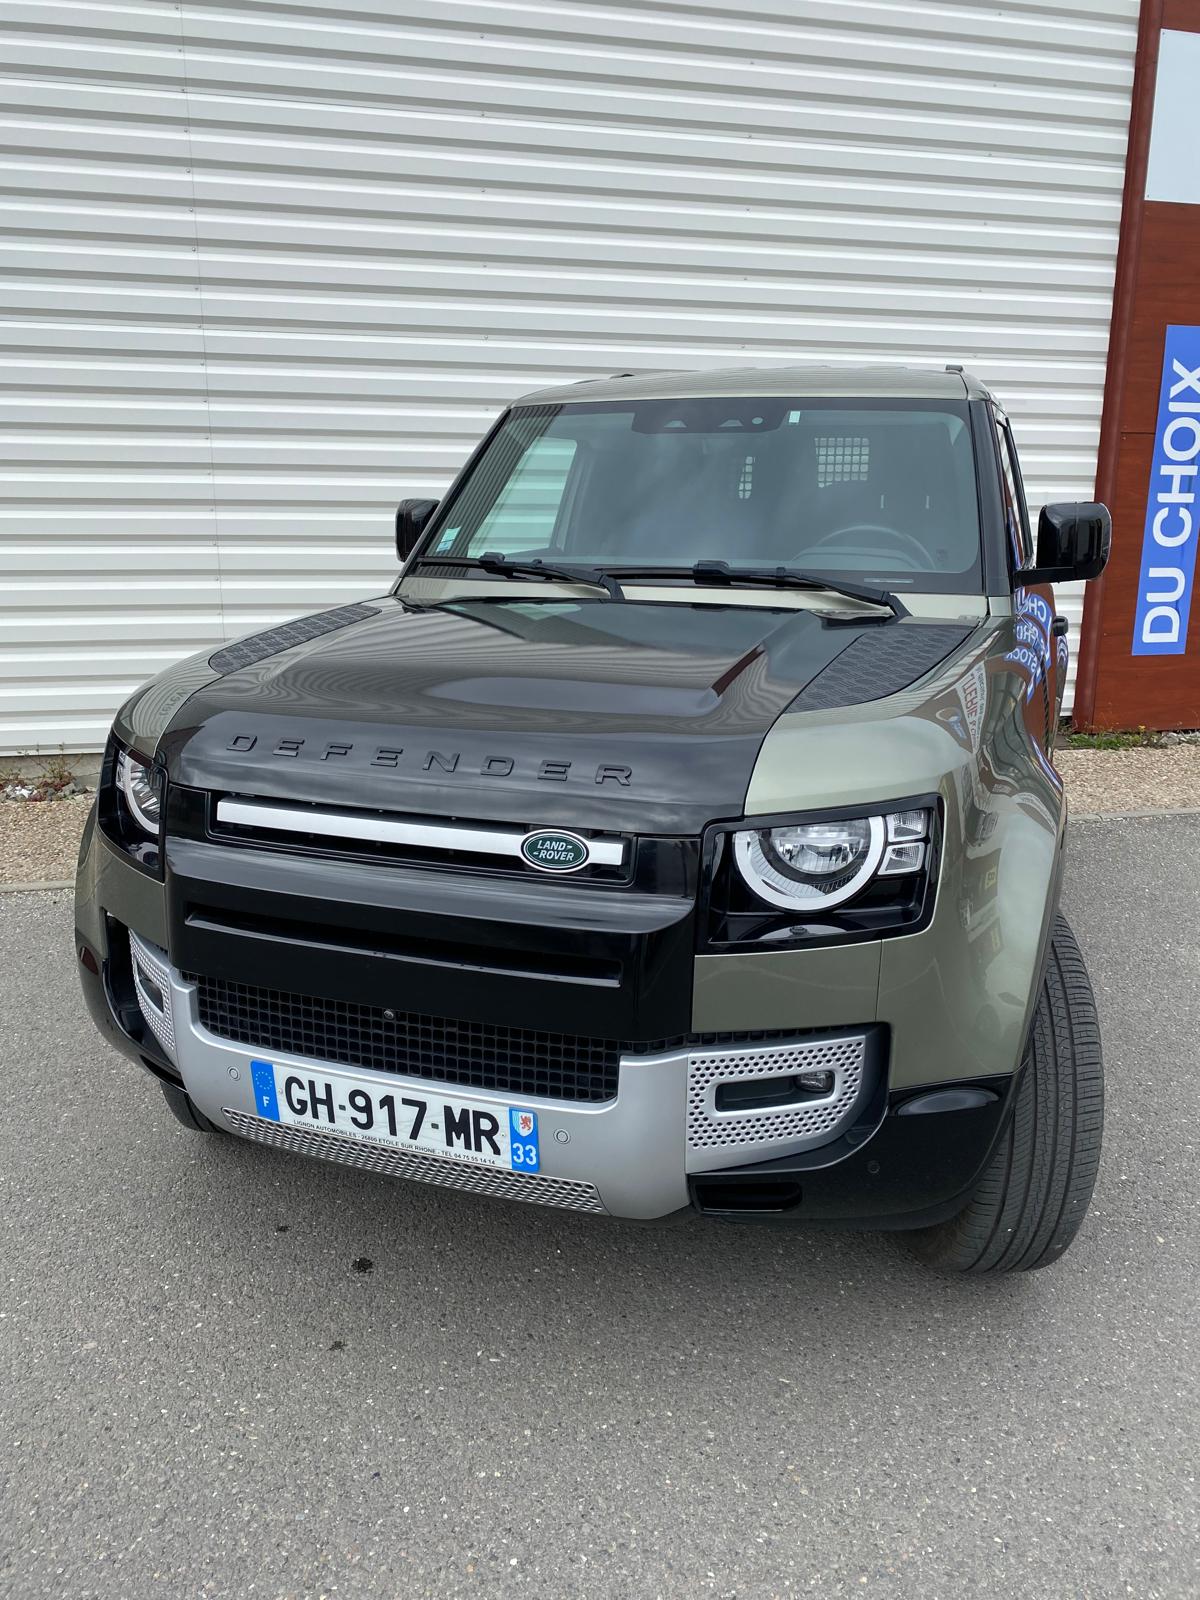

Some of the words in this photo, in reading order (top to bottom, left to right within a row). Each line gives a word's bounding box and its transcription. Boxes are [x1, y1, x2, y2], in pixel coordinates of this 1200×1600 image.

[1152, 358, 1200, 548] CHOIX
[1142, 567, 1186, 644] DU
[226, 734, 633, 787] DEFENDER
[262, 1095, 271, 1108] F
[284, 1075, 502, 1156] GH-917-MR
[512, 1142, 538, 1166] 33
